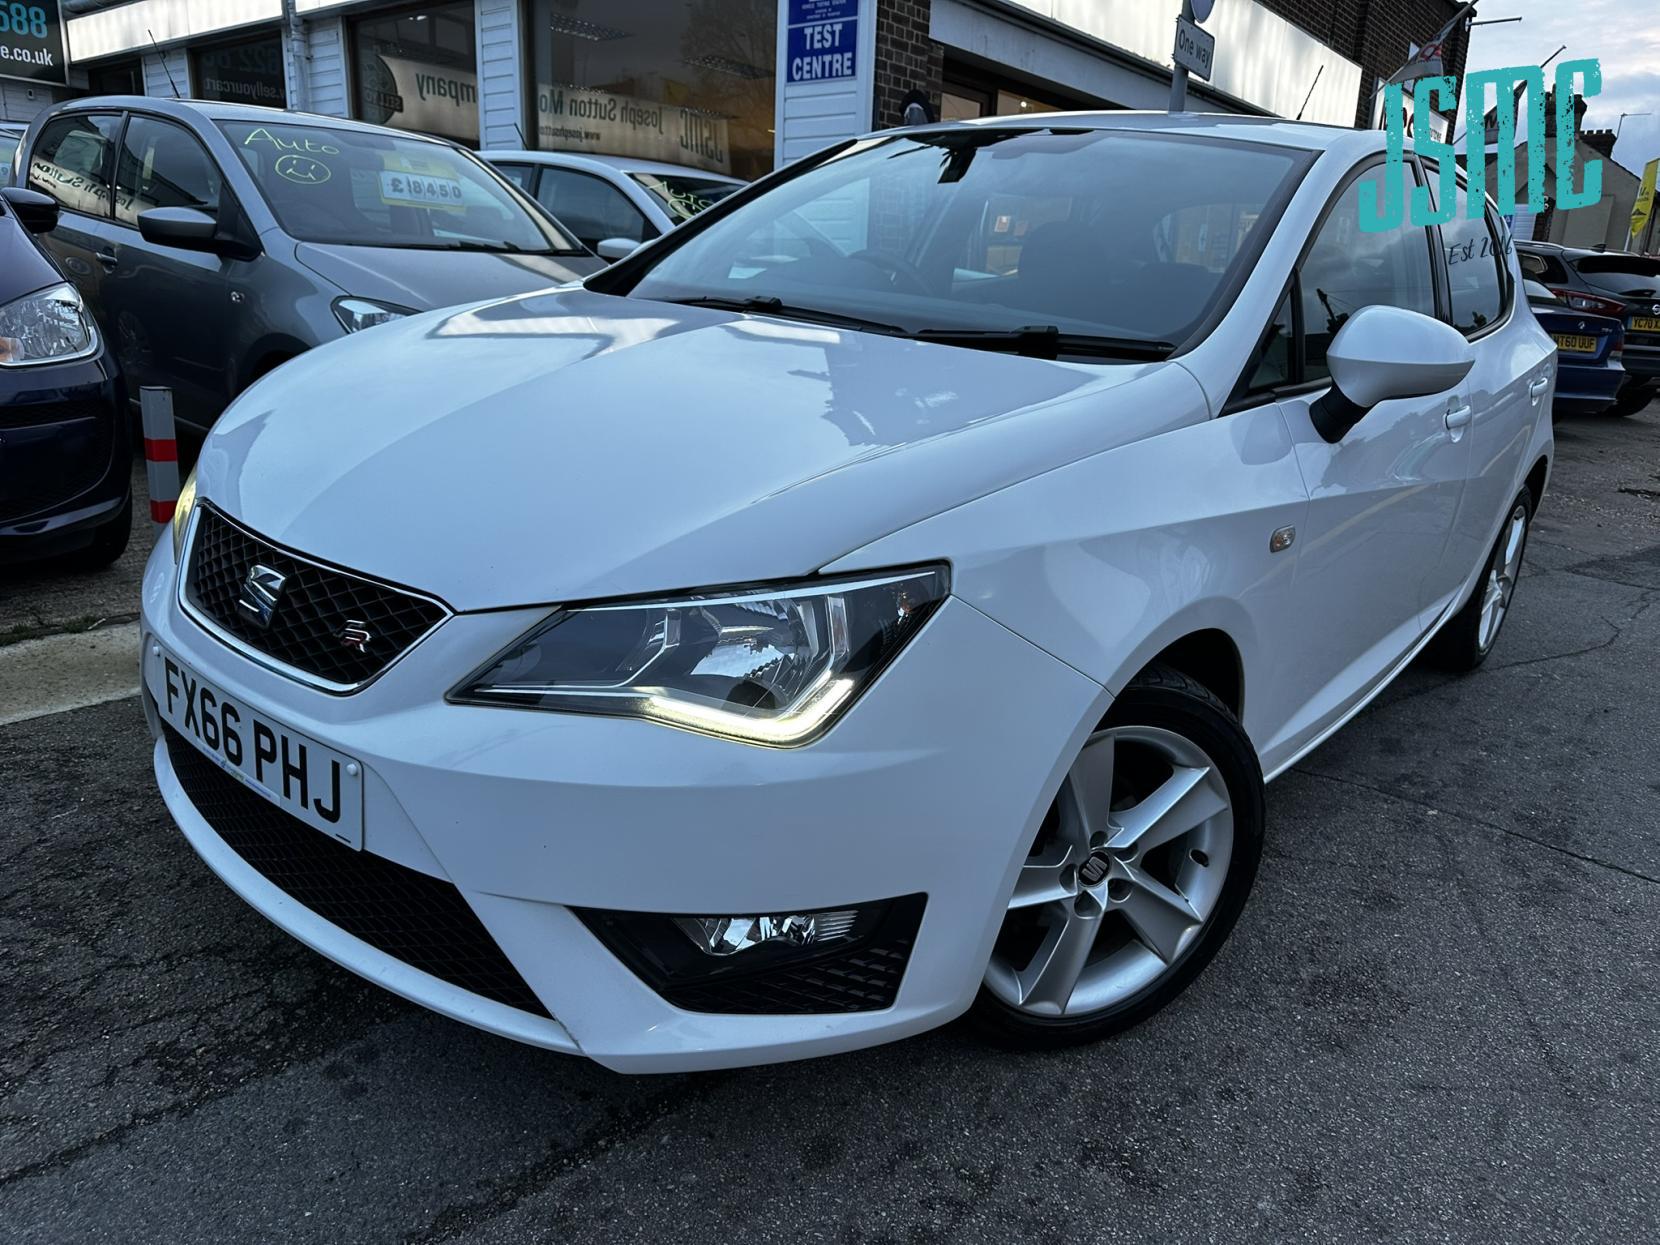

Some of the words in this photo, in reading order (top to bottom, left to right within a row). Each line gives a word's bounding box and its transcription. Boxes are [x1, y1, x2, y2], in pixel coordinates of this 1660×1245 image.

[804, 23, 842, 50] TEST
[1179, 29, 1194, 55] One
[1196, 44, 1210, 69] way
[792, 52, 852, 80] CENTRE
[244, 127, 340, 155] Auto
[164, 656, 243, 767] FX66
[253, 719, 341, 824] PHJ
